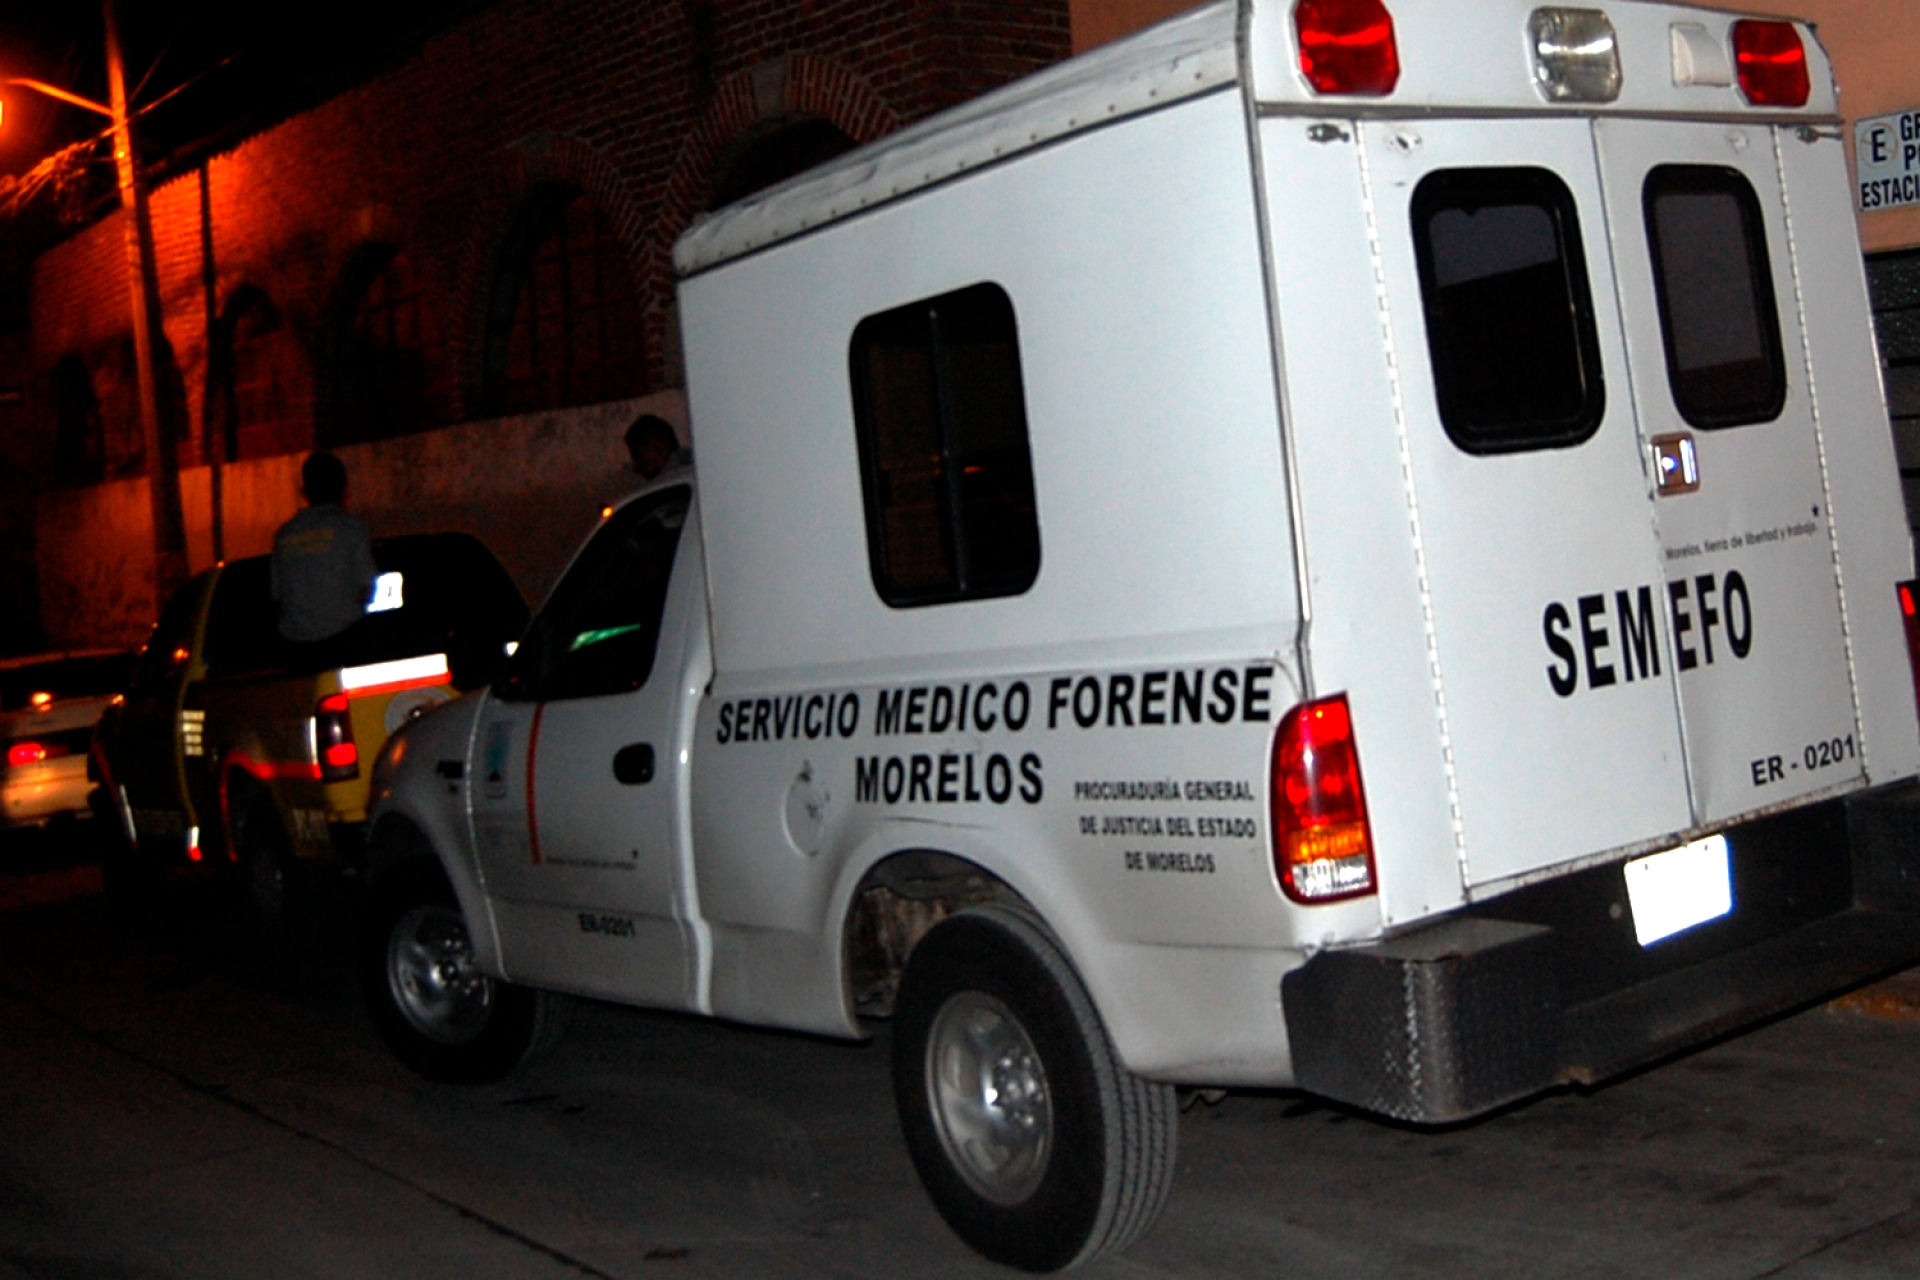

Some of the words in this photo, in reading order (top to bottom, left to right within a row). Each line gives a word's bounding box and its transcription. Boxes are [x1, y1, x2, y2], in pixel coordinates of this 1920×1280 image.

[1871, 127, 1888, 163] E
[1904, 143, 1920, 171] P
[1543, 569, 1753, 698] SEMEFO
[716, 693, 860, 745] SERVICIO
[874, 680, 1031, 736] MEDICO
[1046, 666, 1274, 730] FORENSE
[1750, 754, 1785, 787] ER
[1803, 732, 1855, 771] 0201
[855, 752, 1044, 805] MORELOS
[1183, 780, 1255, 801] GENERAL
[1079, 815, 1098, 836] DE
[1101, 815, 1164, 837] JUSTICIA
[1165, 817, 1195, 838] DEL
[1197, 816, 1257, 839] ESTADO
[1124, 850, 1144, 871] DE
[1146, 851, 1216, 874] MORELOS
